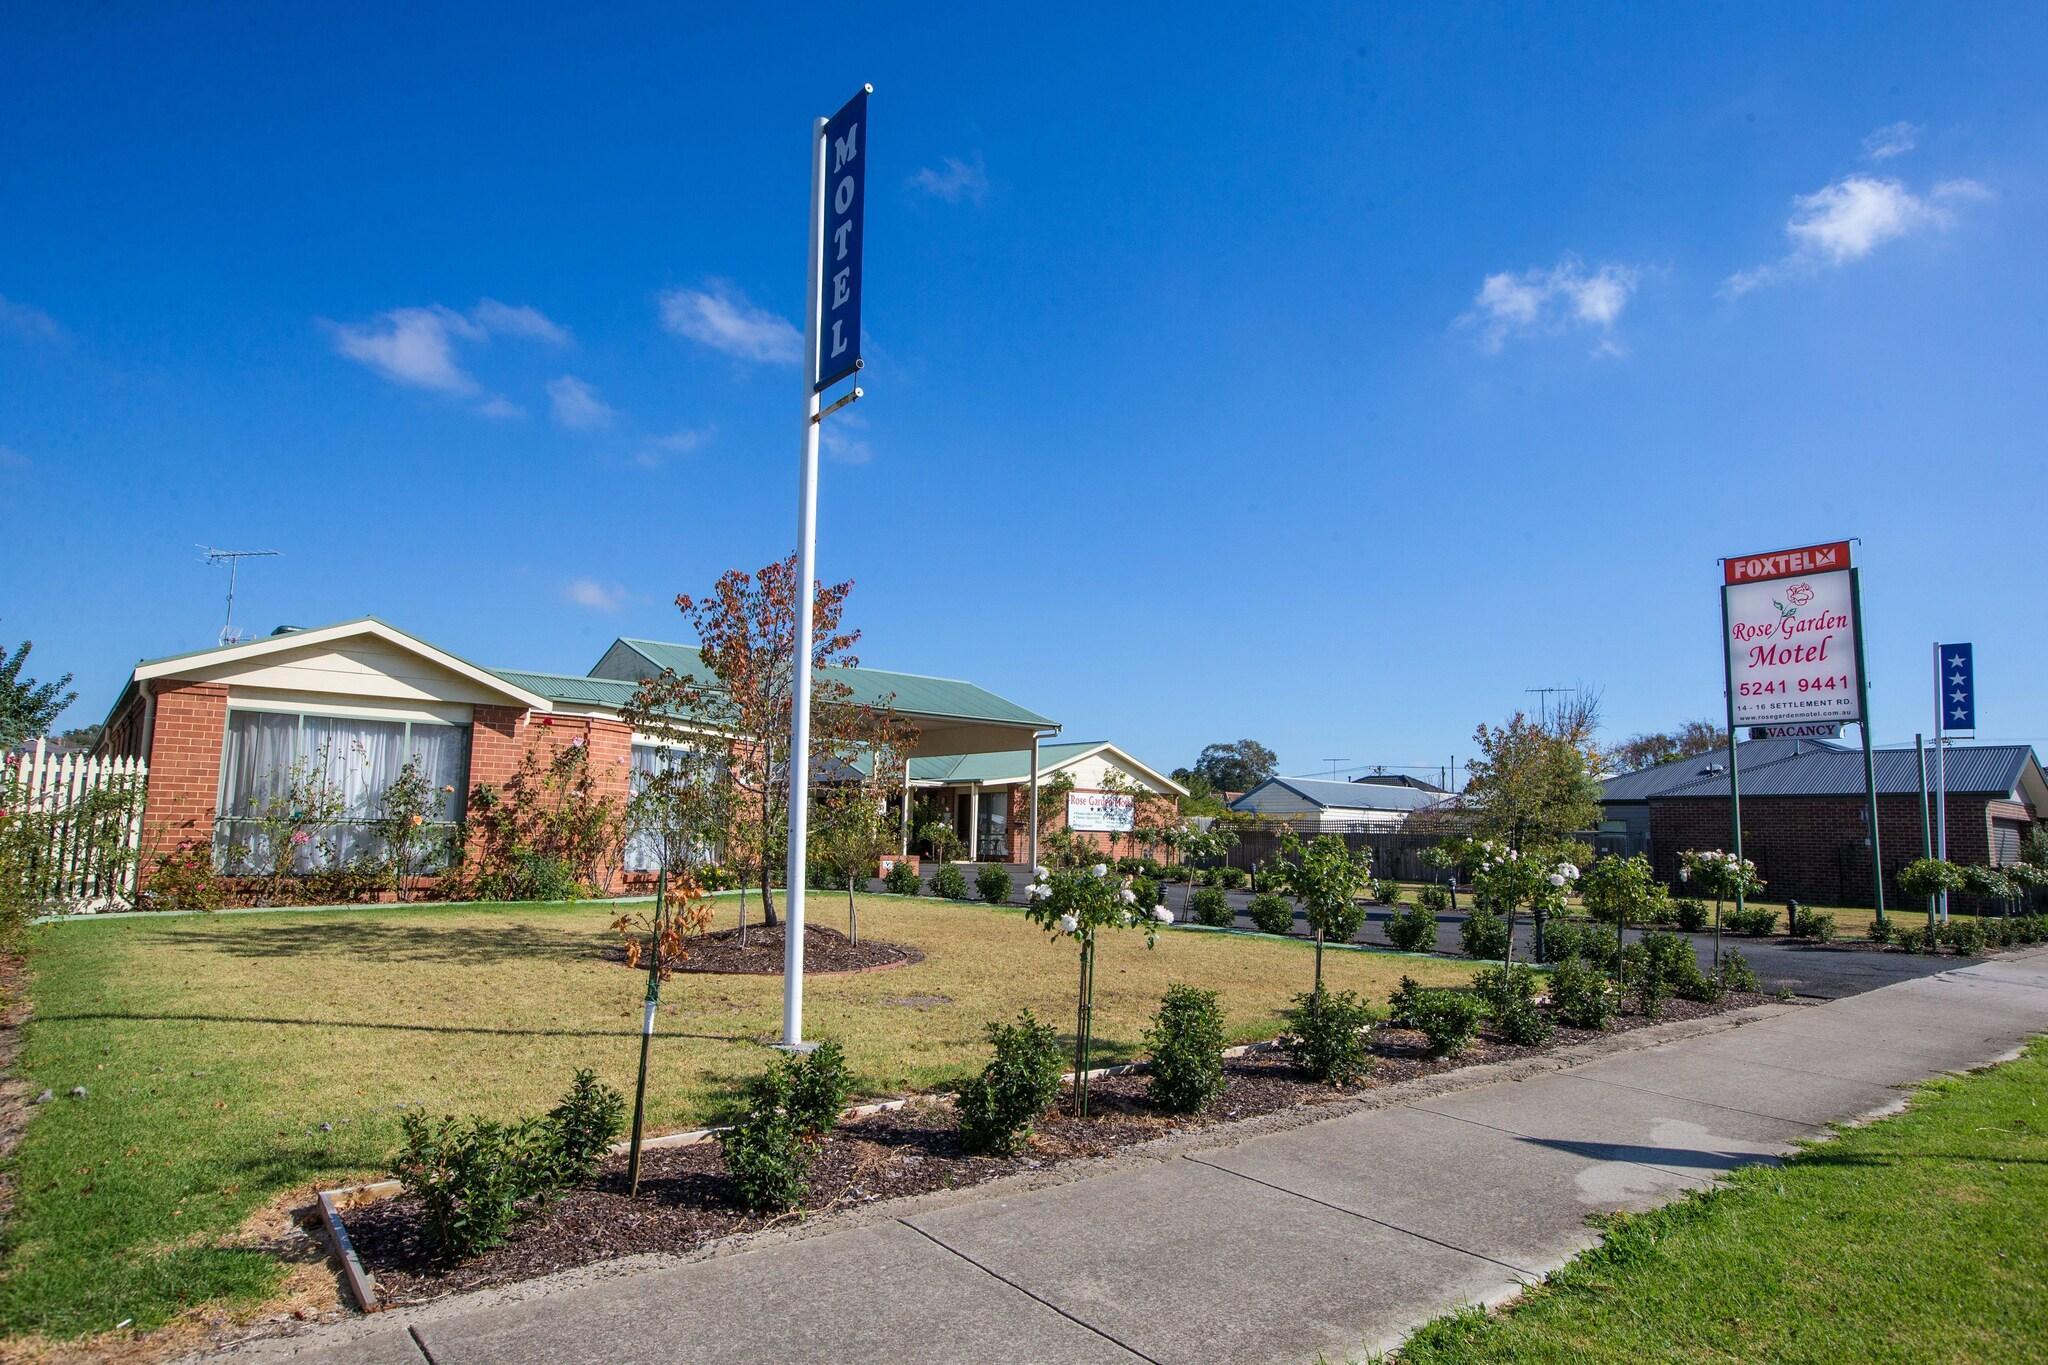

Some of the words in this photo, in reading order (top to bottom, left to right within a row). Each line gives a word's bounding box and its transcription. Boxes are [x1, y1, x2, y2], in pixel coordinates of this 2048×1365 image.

[831, 122, 858, 359] MOTEL
[1734, 553, 1815, 579] FOXTEL
[1732, 622, 1773, 641] Rose
[1780, 610, 1848, 640] Garden
[1748, 636, 1832, 668] Motel
[1739, 680, 1787, 697] 5241
[1798, 675, 1848, 693] 9441
[1770, 700, 1832, 709] SETTLEMENT
[1836, 698, 1853, 706] RD.
[1740, 711, 1851, 721] www.rosegardenmotel.com.au
[1768, 725, 1835, 737] VACANCY
[1071, 795, 1086, 805] Rose
